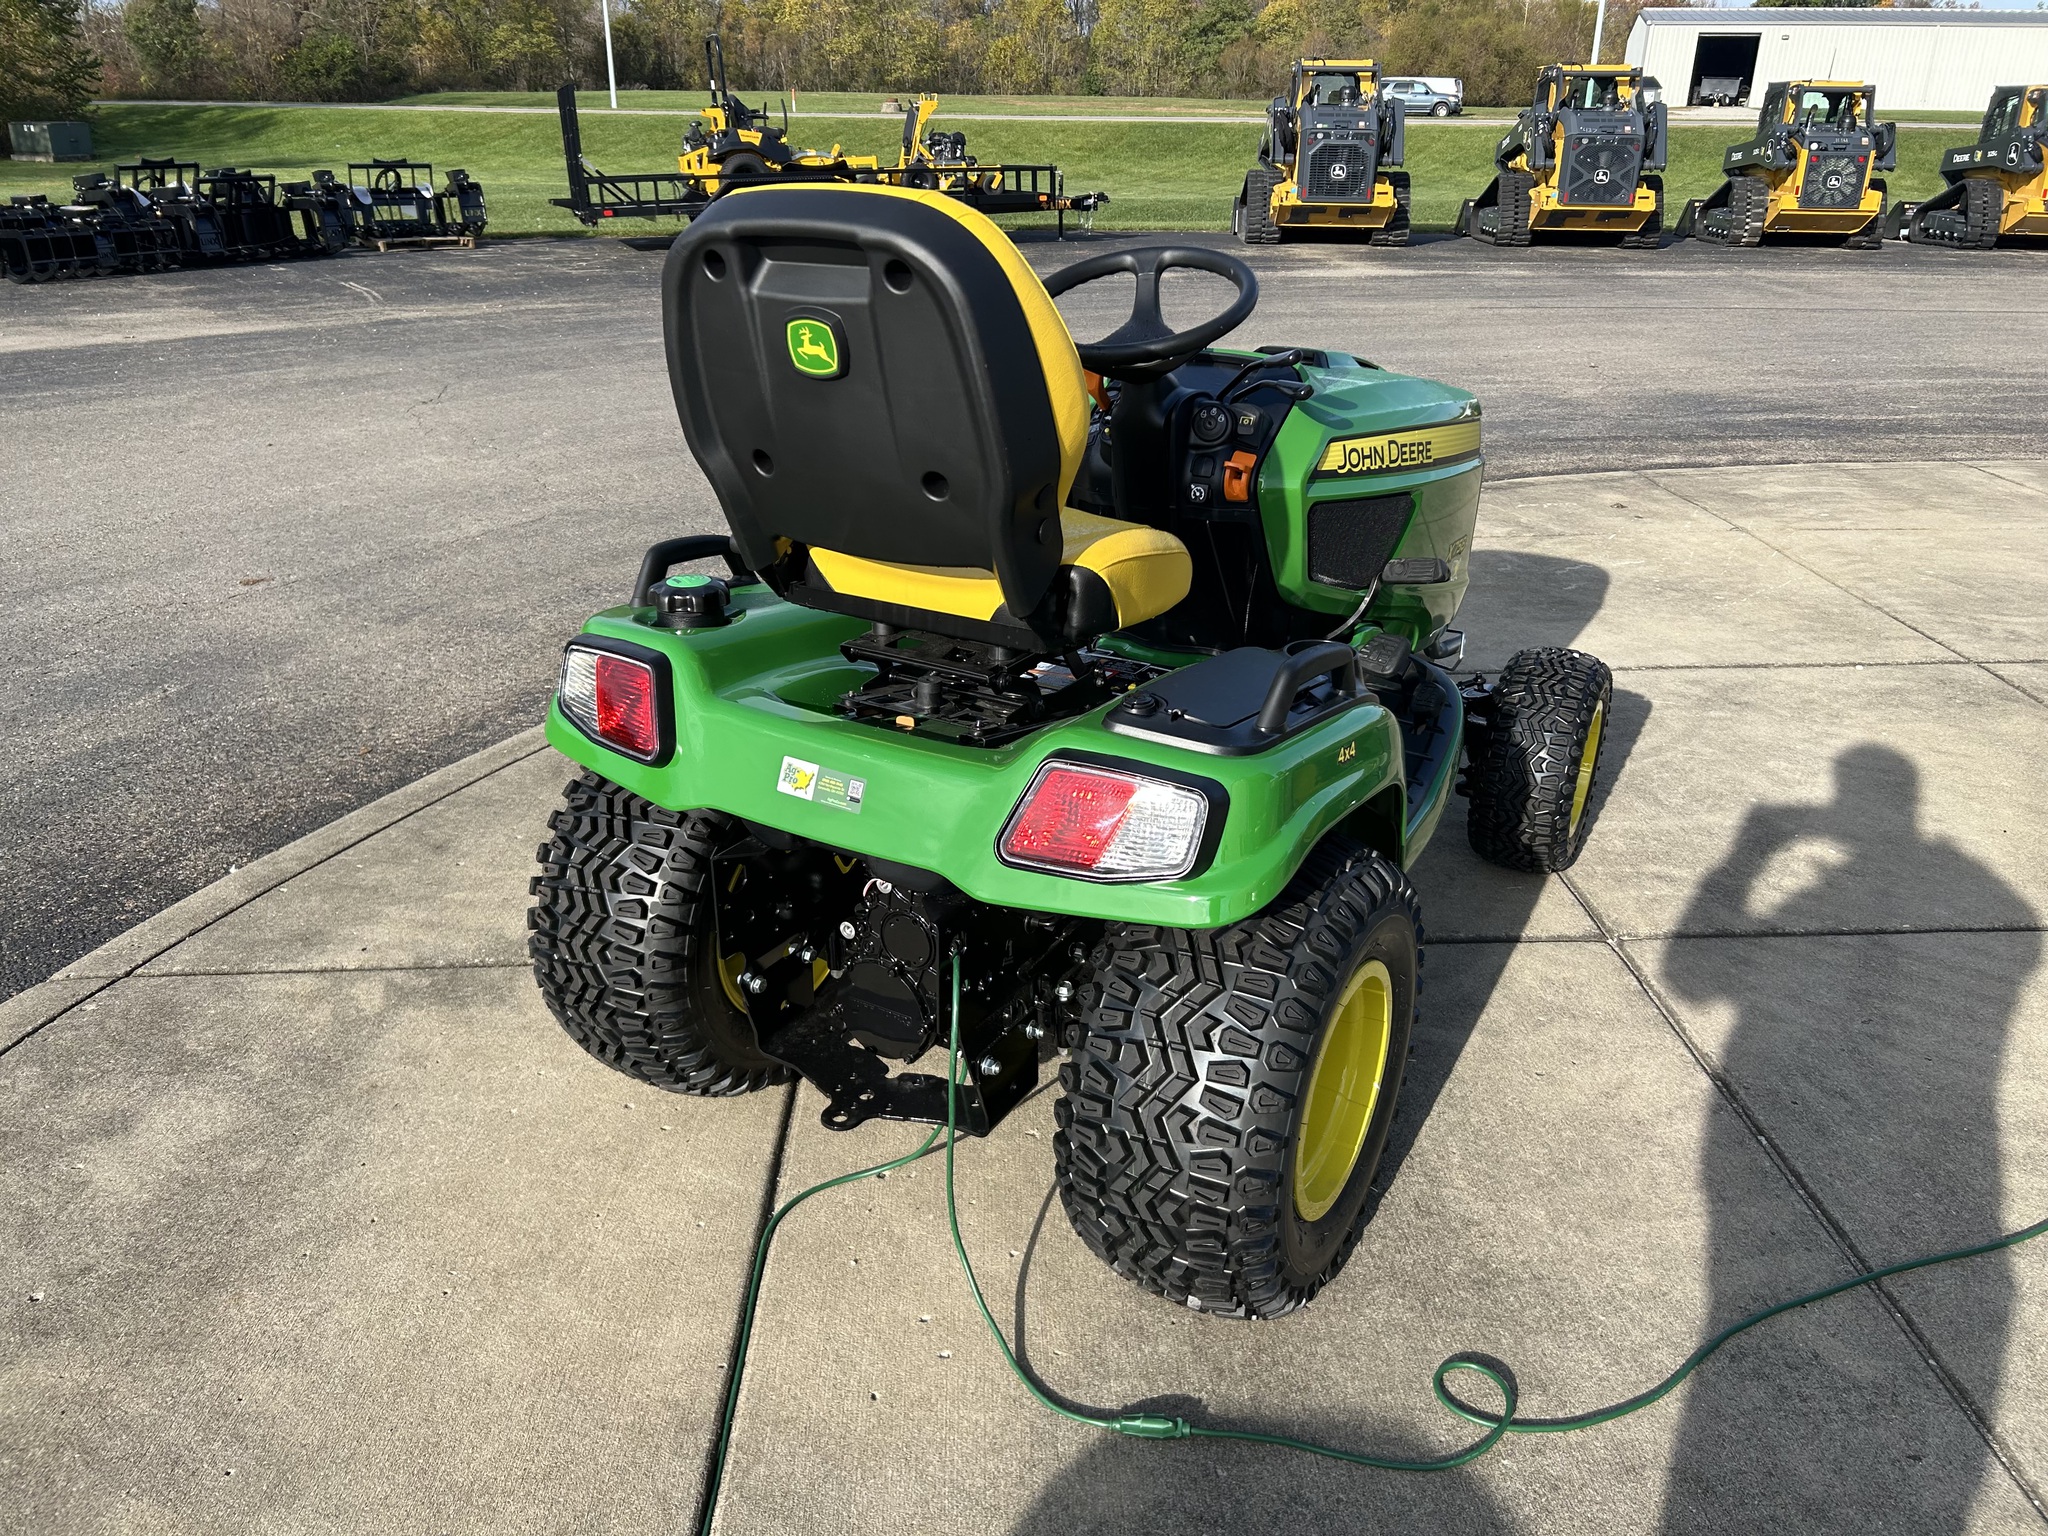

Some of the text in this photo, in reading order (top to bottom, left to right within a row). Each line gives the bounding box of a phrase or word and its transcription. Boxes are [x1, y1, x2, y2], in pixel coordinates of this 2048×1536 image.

[1050, 199, 1072, 210] LINX
[1337, 439, 1433, 471] JOHN DEERE
[1338, 741, 1356, 763] 4x4
[782, 772, 798, 785] Pro
